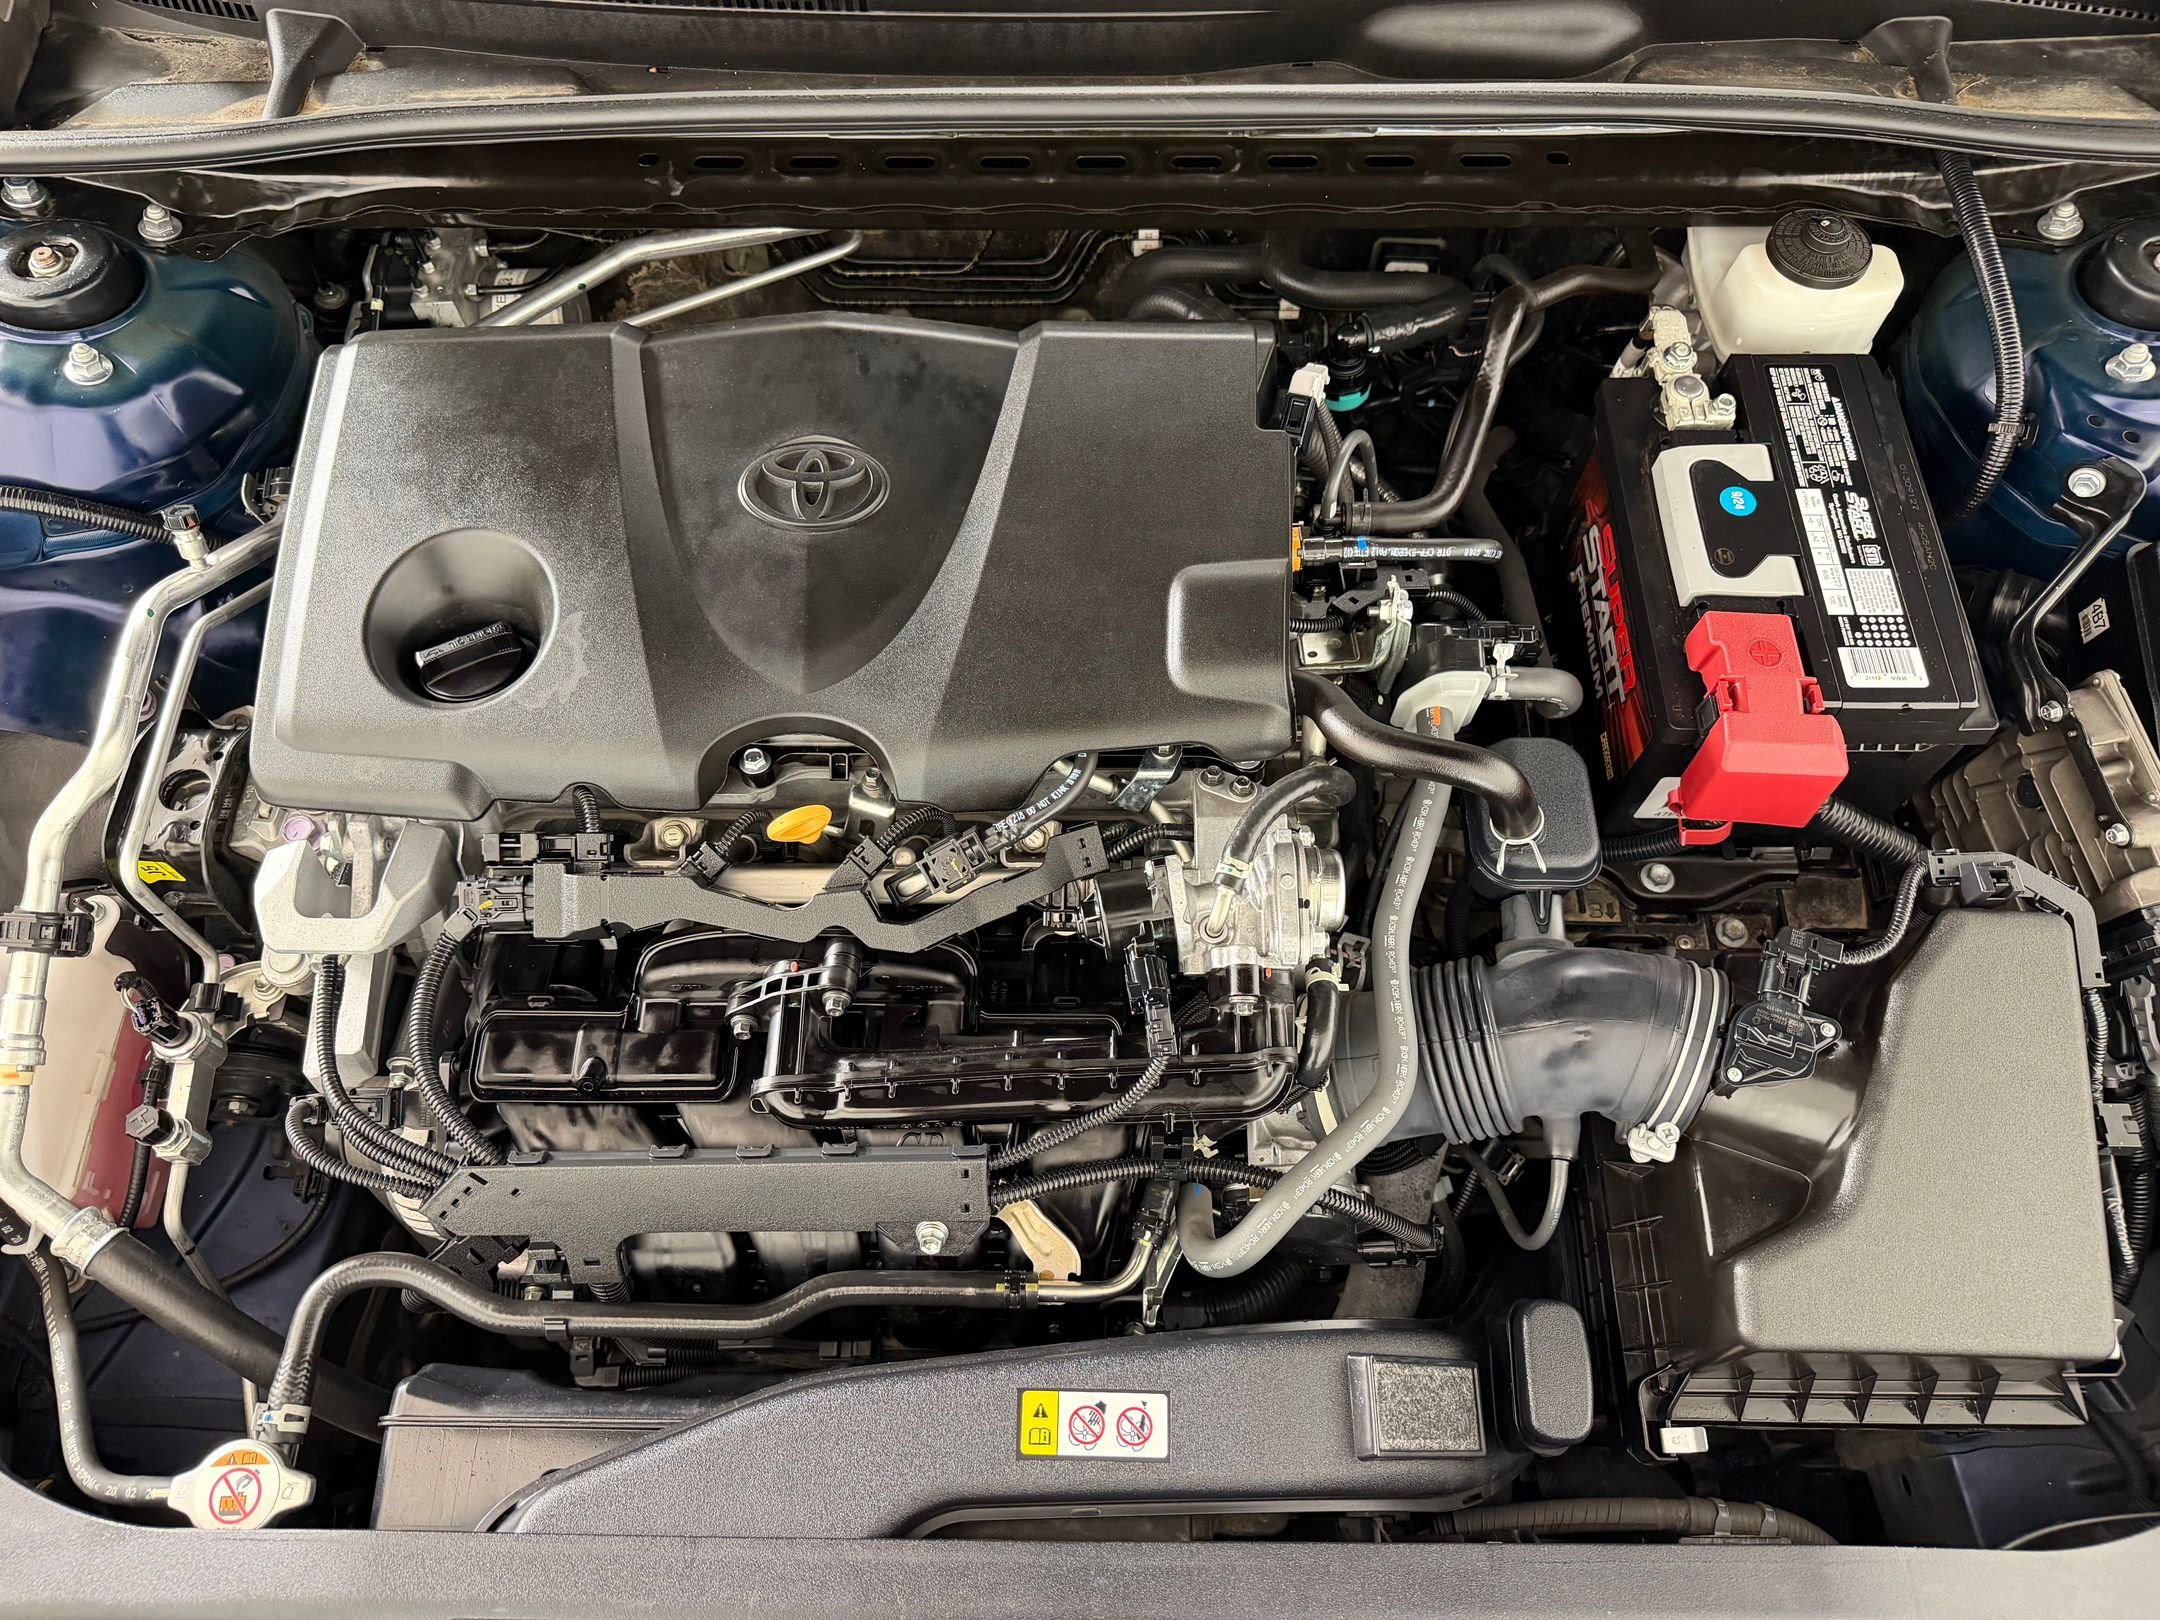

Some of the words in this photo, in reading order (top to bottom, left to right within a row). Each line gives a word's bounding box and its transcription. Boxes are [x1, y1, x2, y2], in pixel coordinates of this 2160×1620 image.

[1731, 491, 1746, 510] 9/24
[1845, 491, 1866, 540] START
[1861, 497, 1877, 540] SUPER
[1574, 563, 1604, 700] PREMIUM
[1582, 523, 1626, 704] START
[1602, 523, 1636, 694] SUPER
[2092, 604, 2106, 629] 4B7
[1027, 806, 1037, 817] DO
[1037, 796, 1052, 811] NOT
[1051, 783, 1070, 801] KINK
